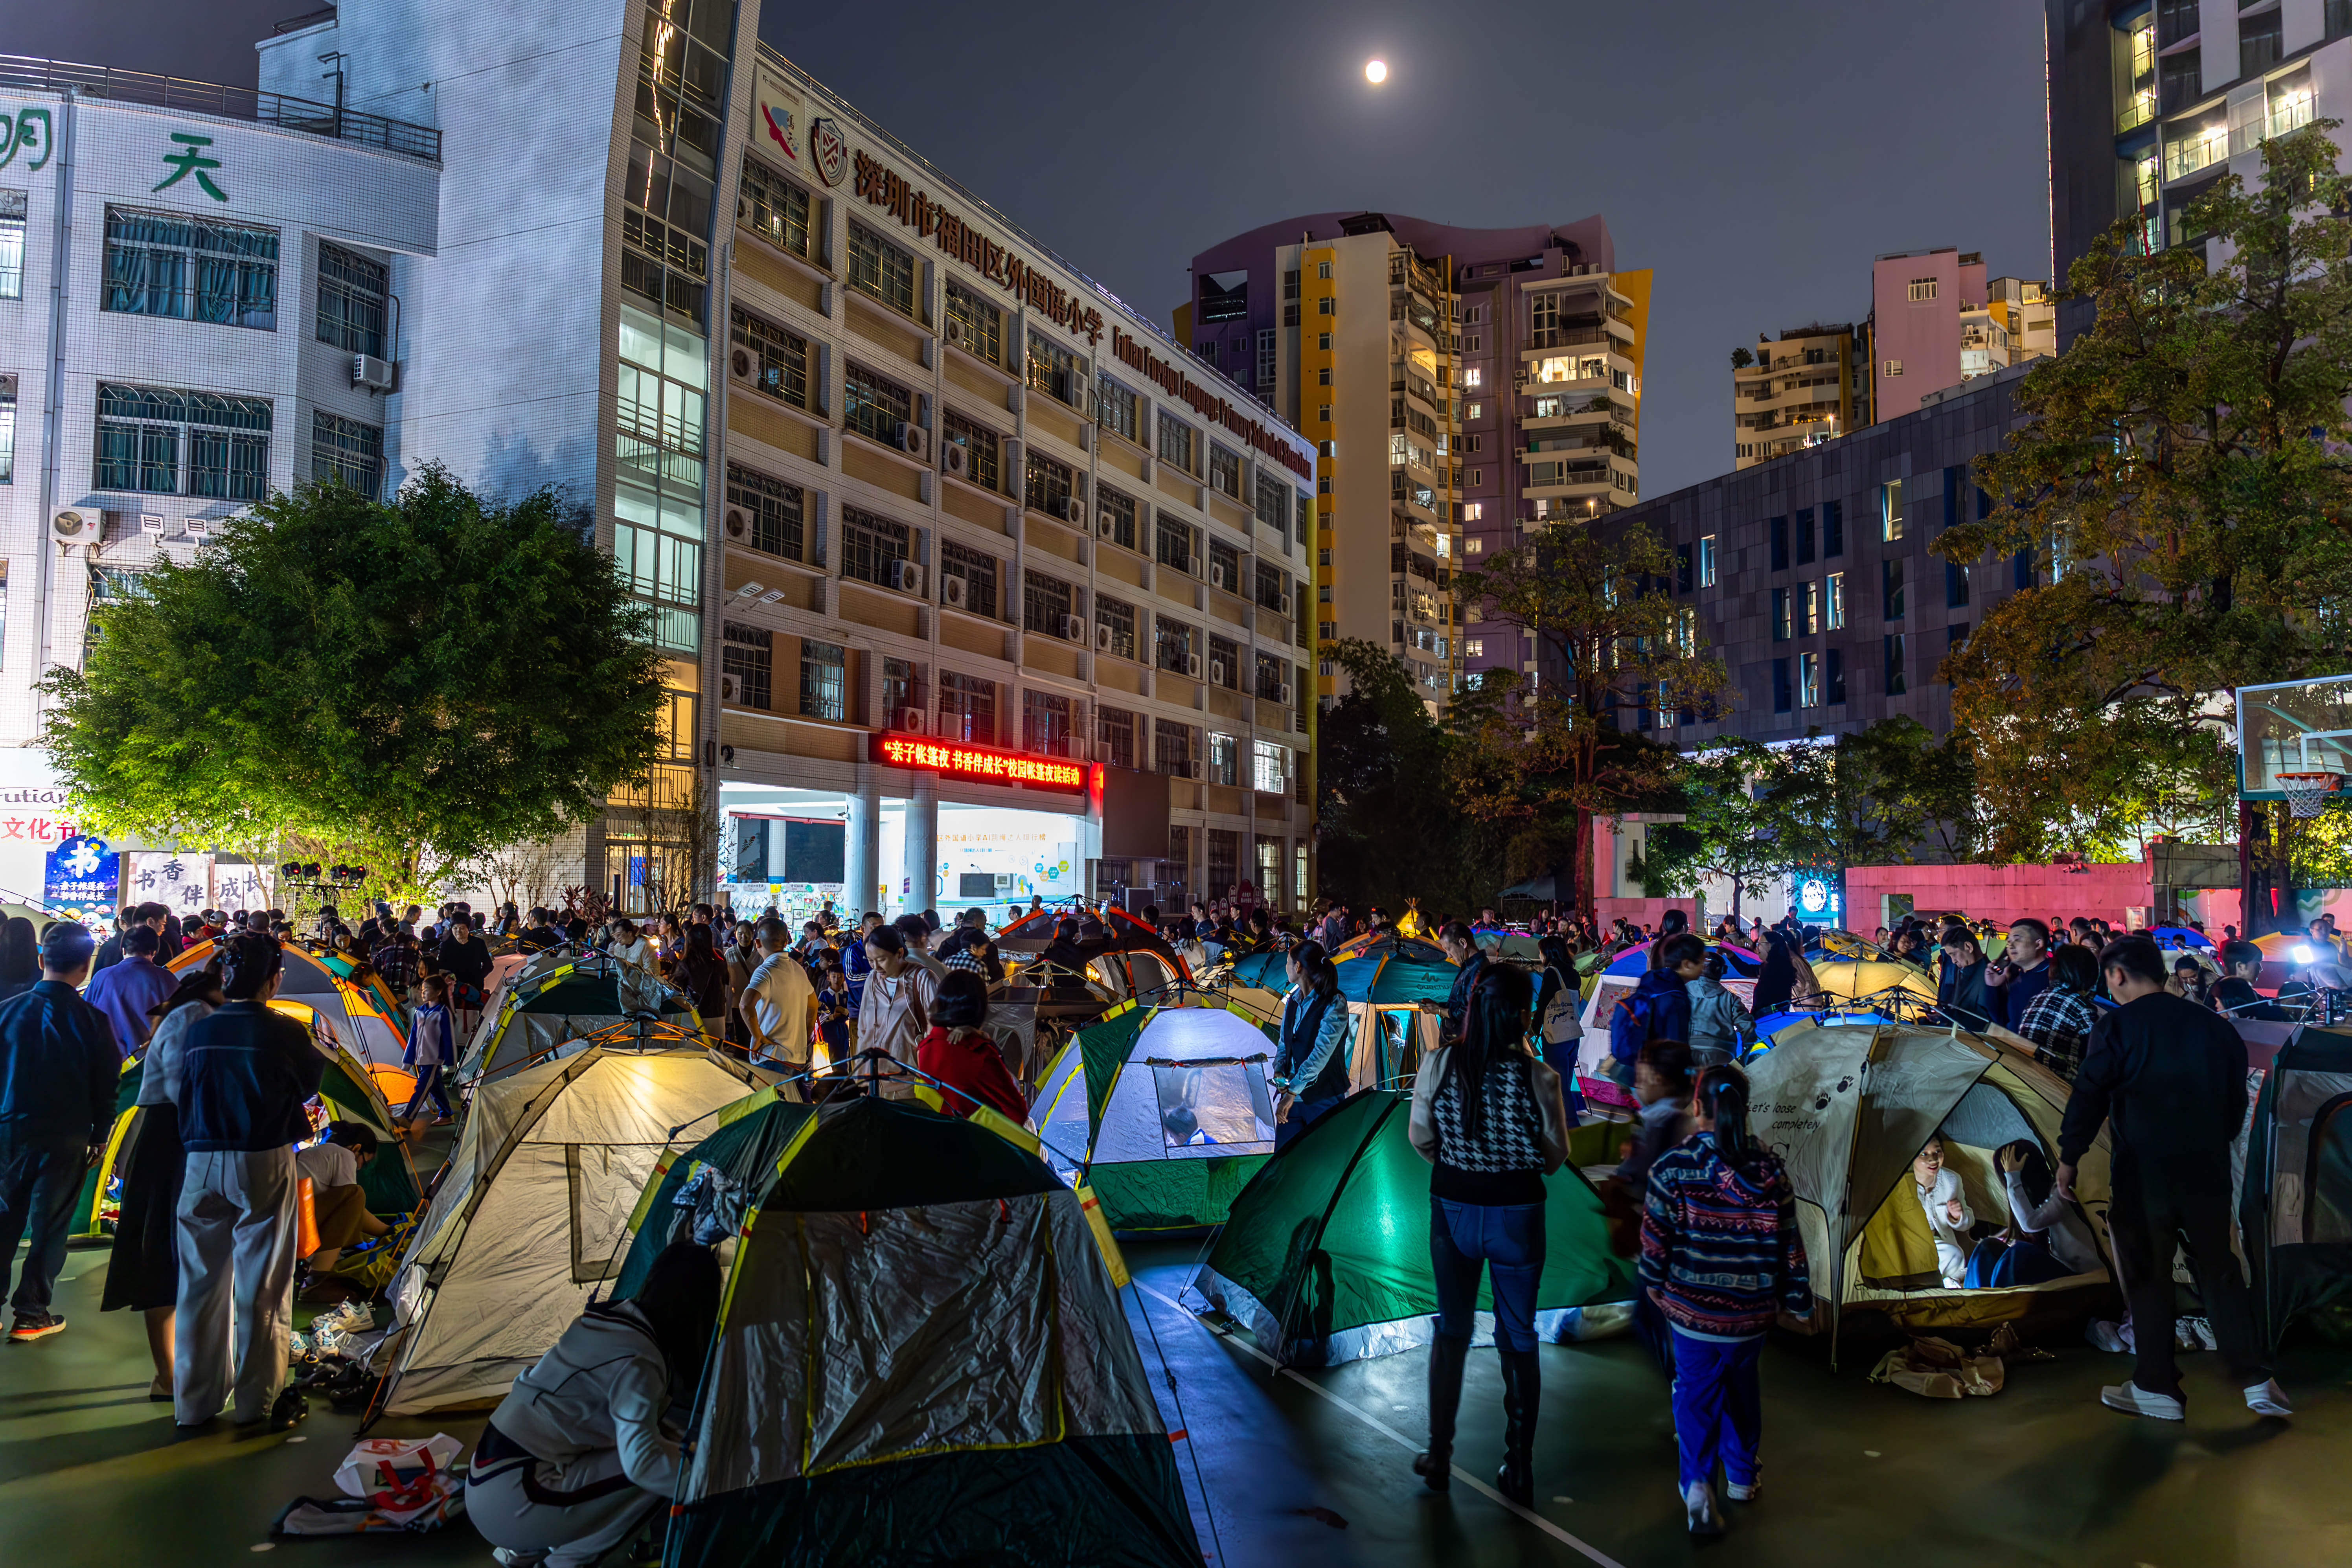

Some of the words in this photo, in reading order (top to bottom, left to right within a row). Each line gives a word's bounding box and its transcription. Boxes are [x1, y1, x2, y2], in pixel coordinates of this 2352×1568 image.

[854, 149, 1104, 346] 深圳市福田区外国语小学
[1113, 325, 1144, 373] Futian
[1144, 346, 1179, 397] Foreign
[1179, 371, 1218, 422] Language
[1219, 397, 1251, 446] Primary
[1251, 419, 1275, 458] School
[884, 740, 950, 768] “亲子帐篷夜
[952, 749, 1079, 785] 书香伴成长”校园帐篷夜读活动
[63, 840, 100, 879] 书
[1747, 1102, 1770, 1113] Let's
[1772, 1102, 1796, 1113] loose
[1772, 1118, 1820, 1132] completely
